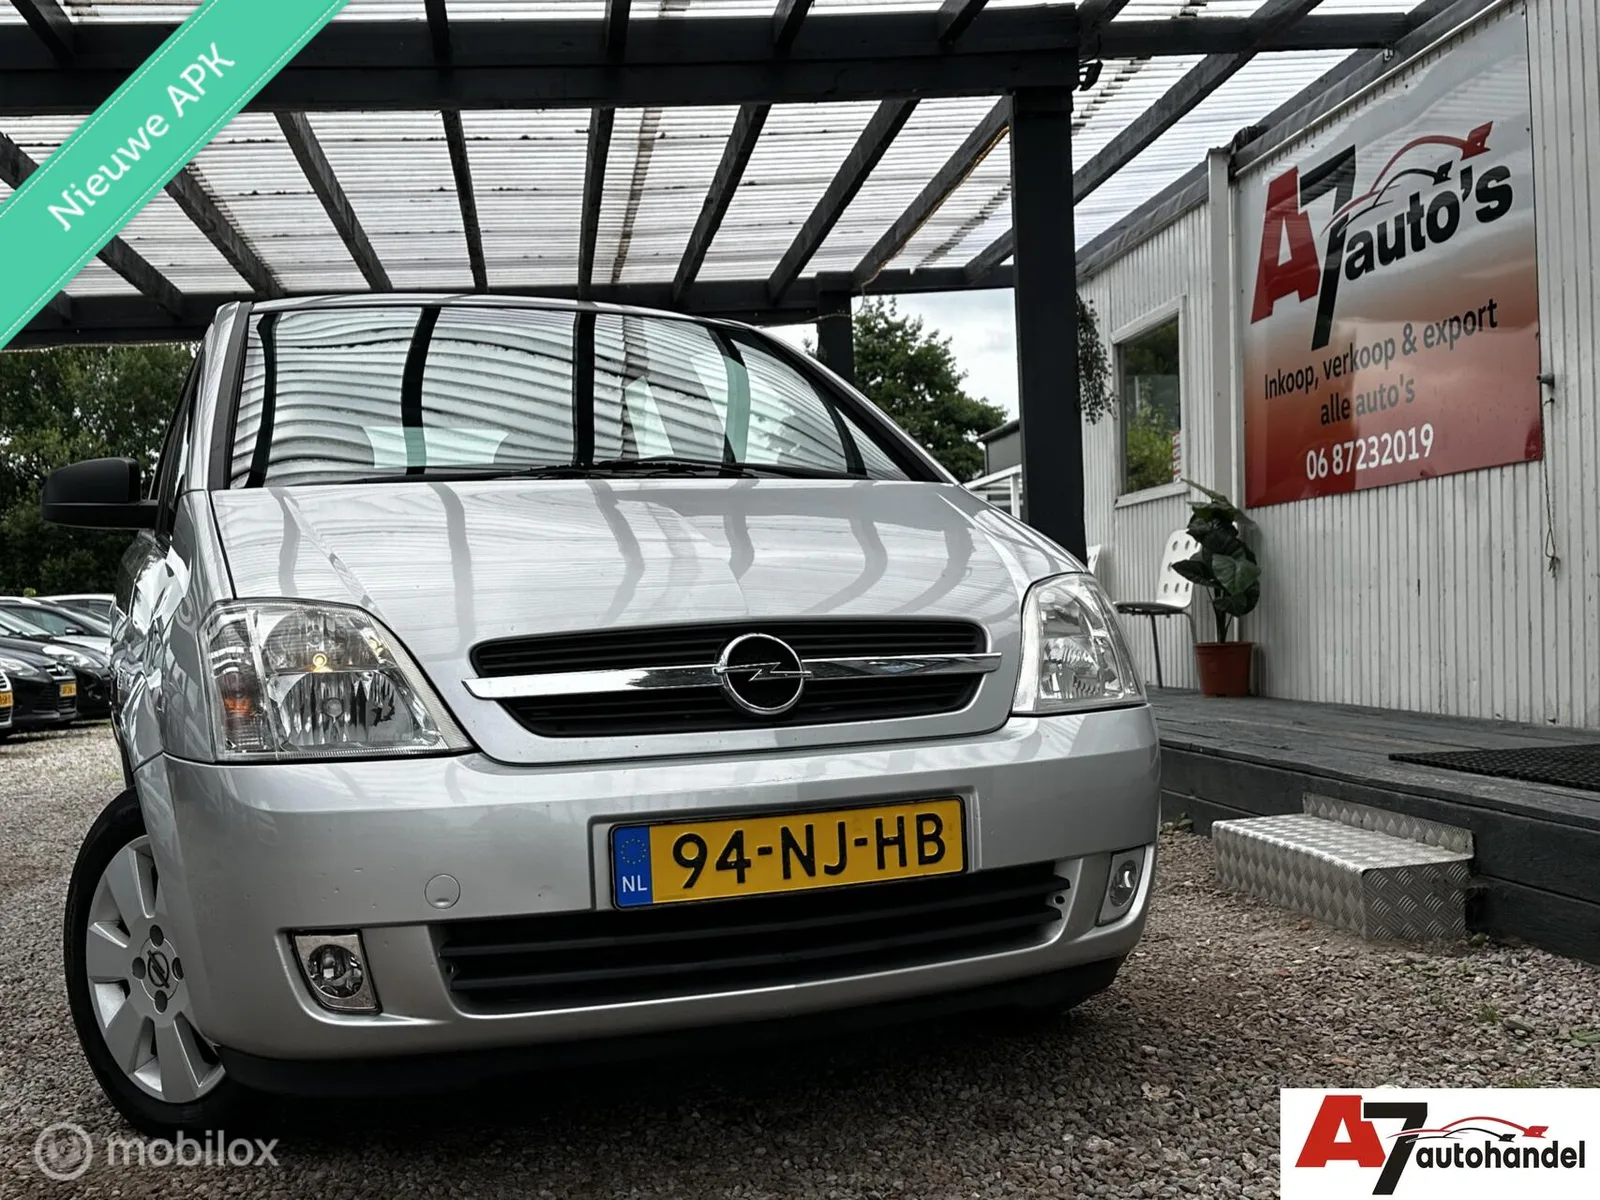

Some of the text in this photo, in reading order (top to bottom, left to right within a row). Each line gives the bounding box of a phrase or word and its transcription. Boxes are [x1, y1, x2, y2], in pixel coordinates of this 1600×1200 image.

[1264, 298, 1498, 400] Inkoop, verkoop & export
[1320, 374, 1416, 426] alle auto's
[1306, 423, 1434, 481] 06 87232019
[672, 812, 947, 889] 94-NJ-HB
[622, 874, 648, 893] NL
